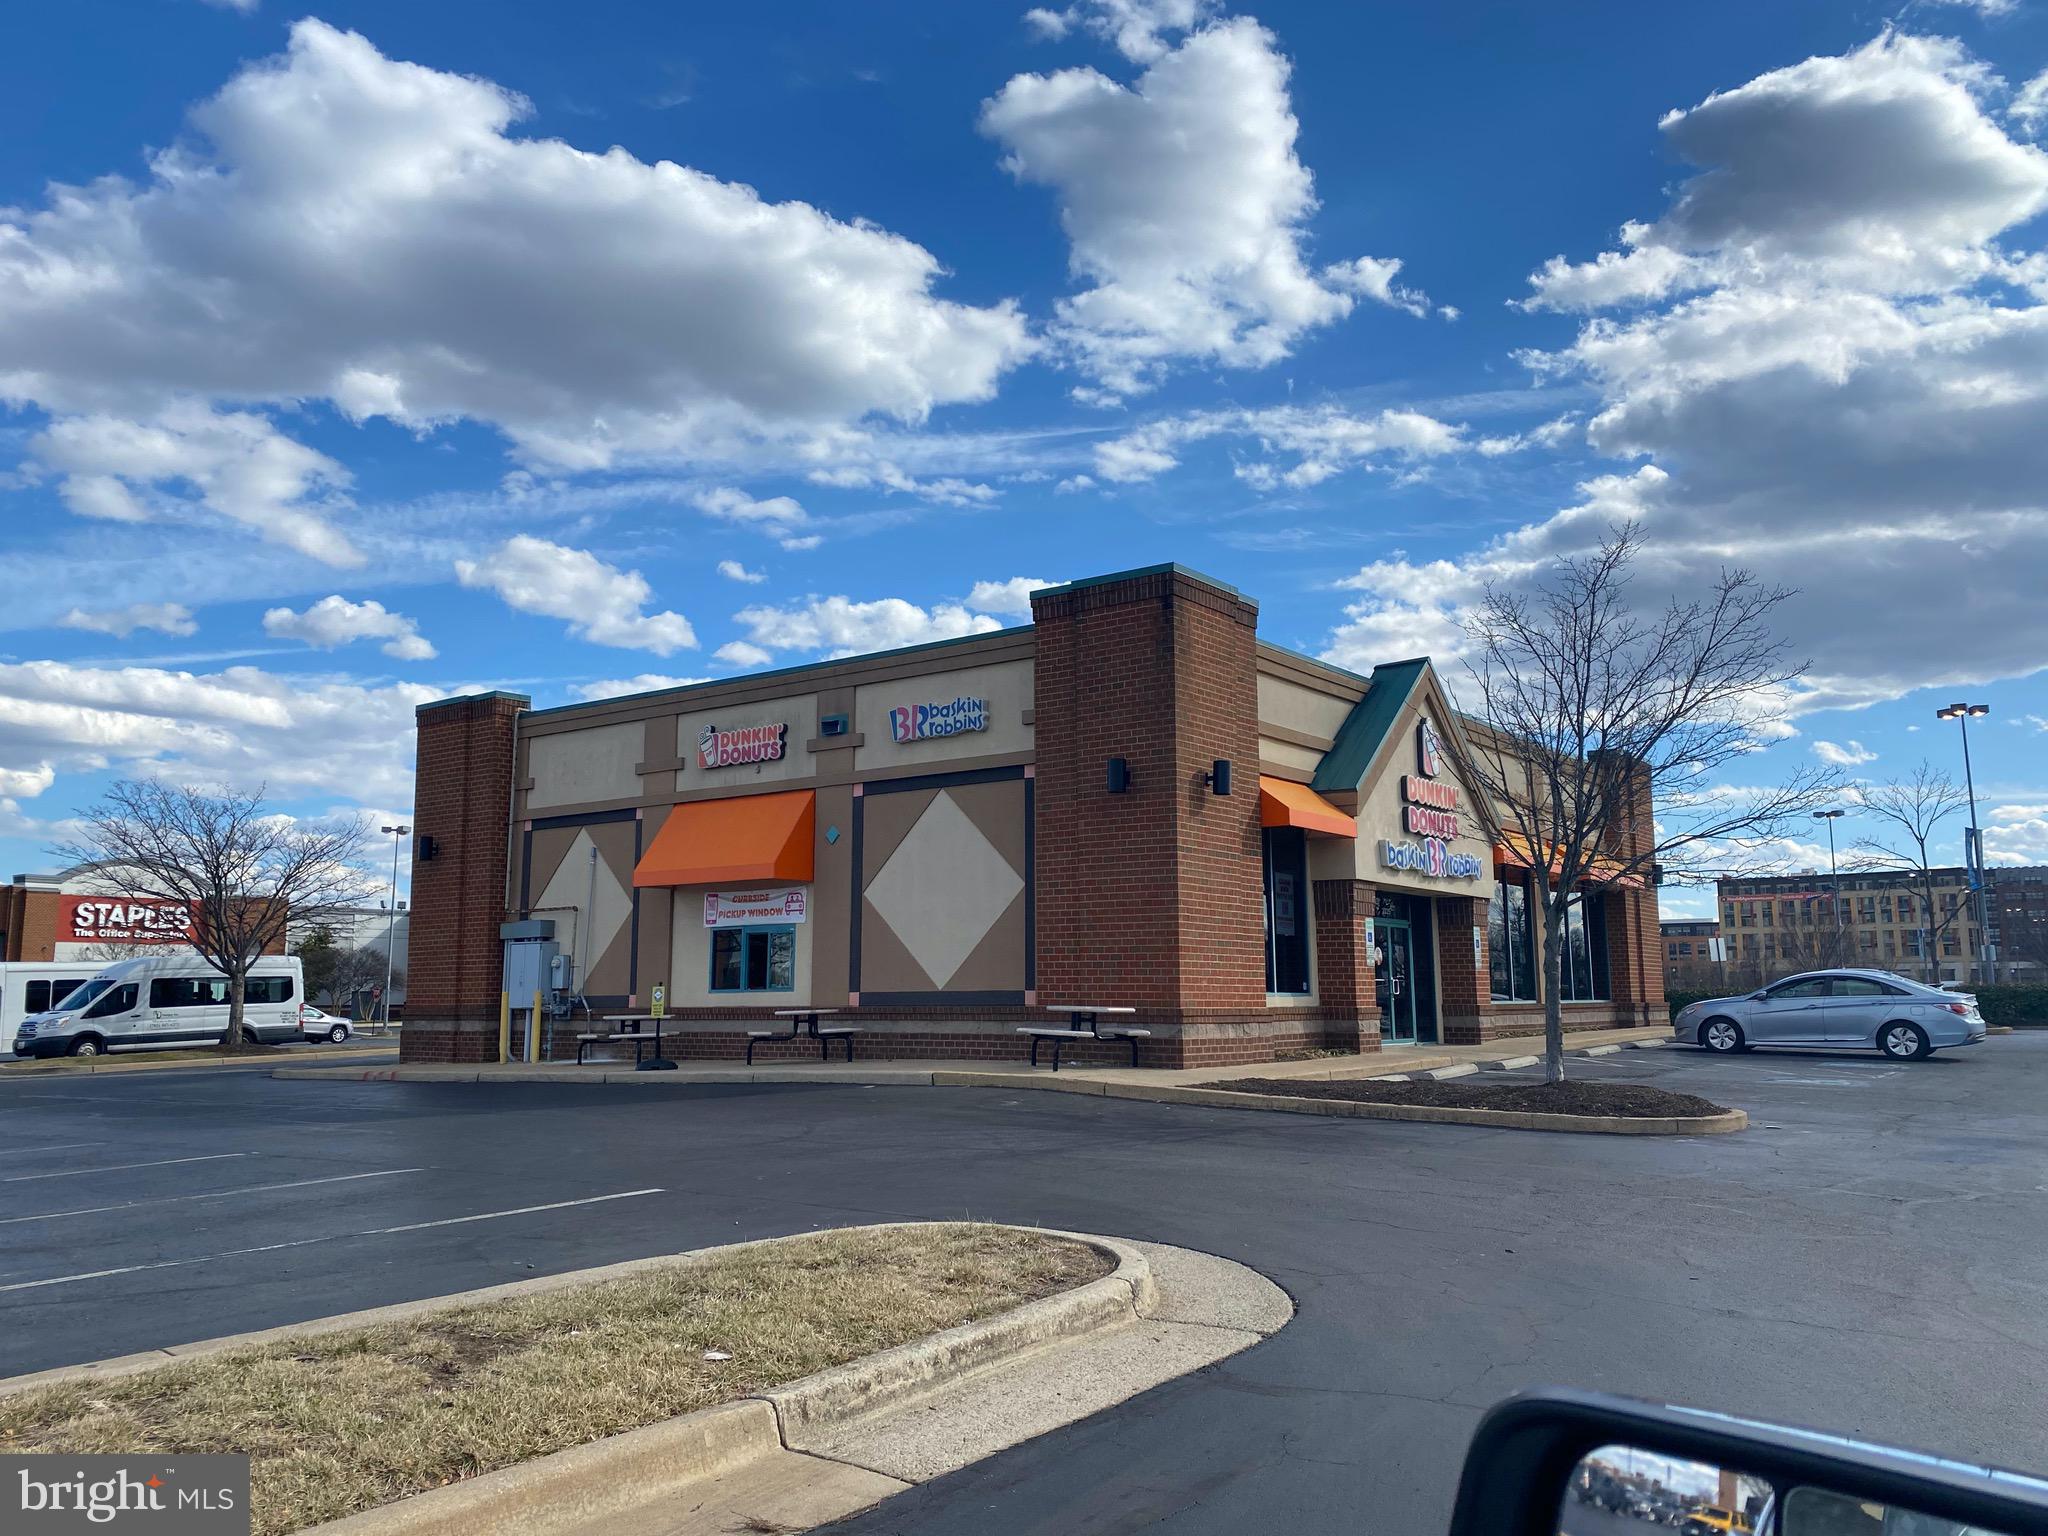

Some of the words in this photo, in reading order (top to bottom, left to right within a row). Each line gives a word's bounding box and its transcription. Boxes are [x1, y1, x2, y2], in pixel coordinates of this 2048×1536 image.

[929, 696, 982, 719] baskin
[720, 724, 783, 749] DUNKIN'
[928, 714, 983, 737] robbins
[719, 741, 780, 765] DONUTS
[1407, 775, 1460, 811] DUNKIN'
[1408, 806, 1459, 840] DONUTS
[1386, 840, 1427, 871] baskin
[1447, 853, 1483, 880] robbins
[732, 893, 770, 904] CURBSIDE
[75, 902, 192, 930] STAPLES
[718, 910, 747, 919] PICKUP
[747, 907, 784, 918] WINDOW
[73, 928, 95, 937] The
[98, 928, 131, 938] Office
